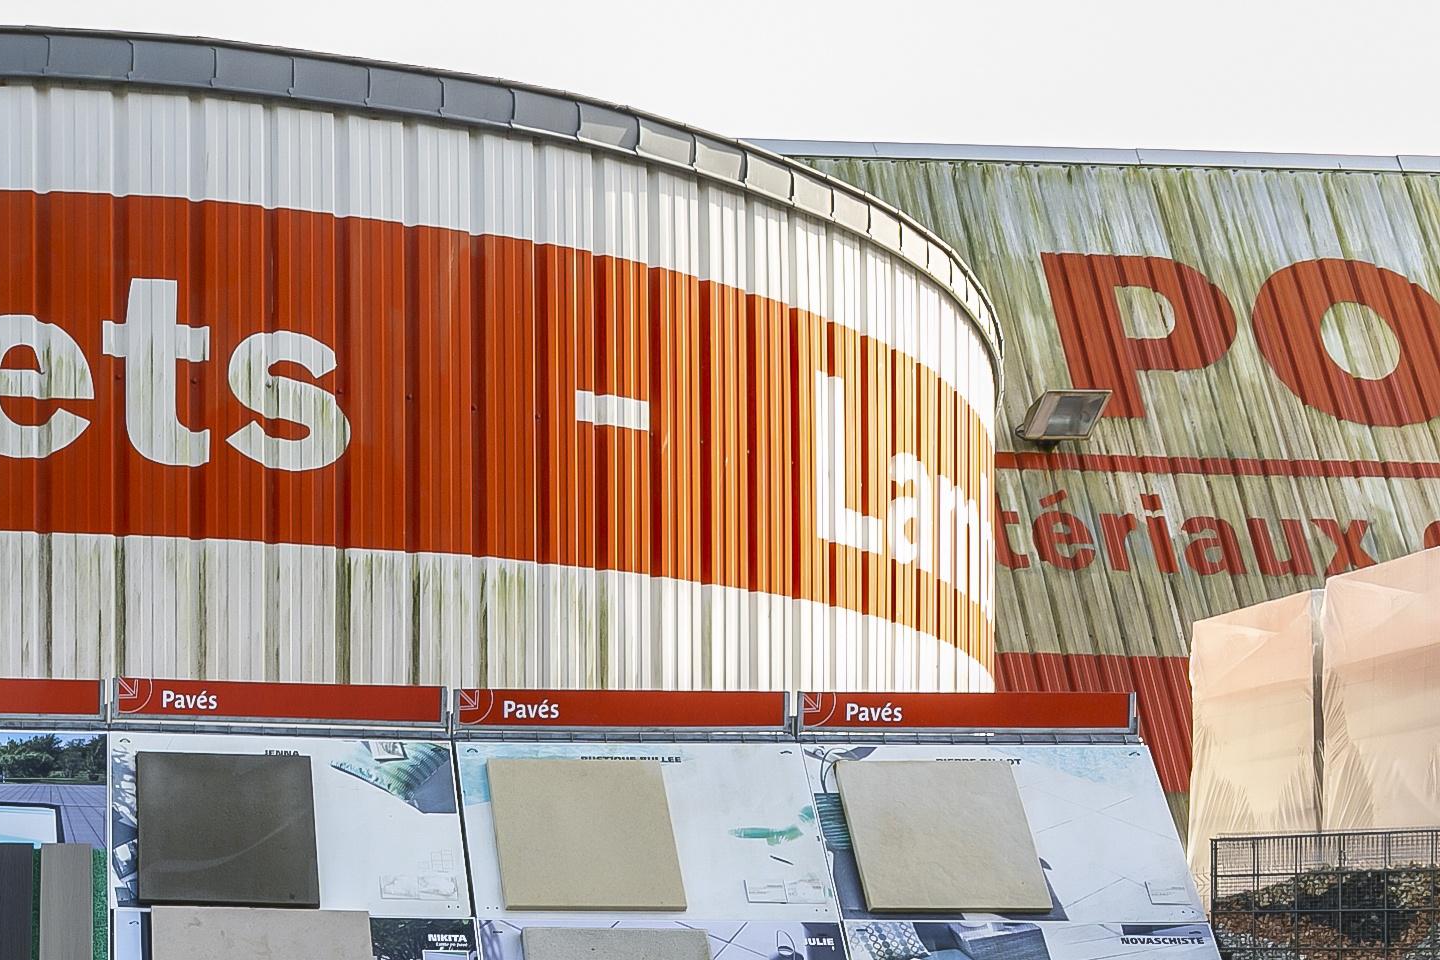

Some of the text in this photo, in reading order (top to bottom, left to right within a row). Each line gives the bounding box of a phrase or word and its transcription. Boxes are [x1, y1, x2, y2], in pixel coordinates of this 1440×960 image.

[161, 690, 218, 710] Pavés
[502, 699, 560, 720] Pavés
[845, 702, 904, 723] Pavés
[427, 933, 468, 943] NIKITA
[1120, 936, 1205, 945] NOVASCHISTE
